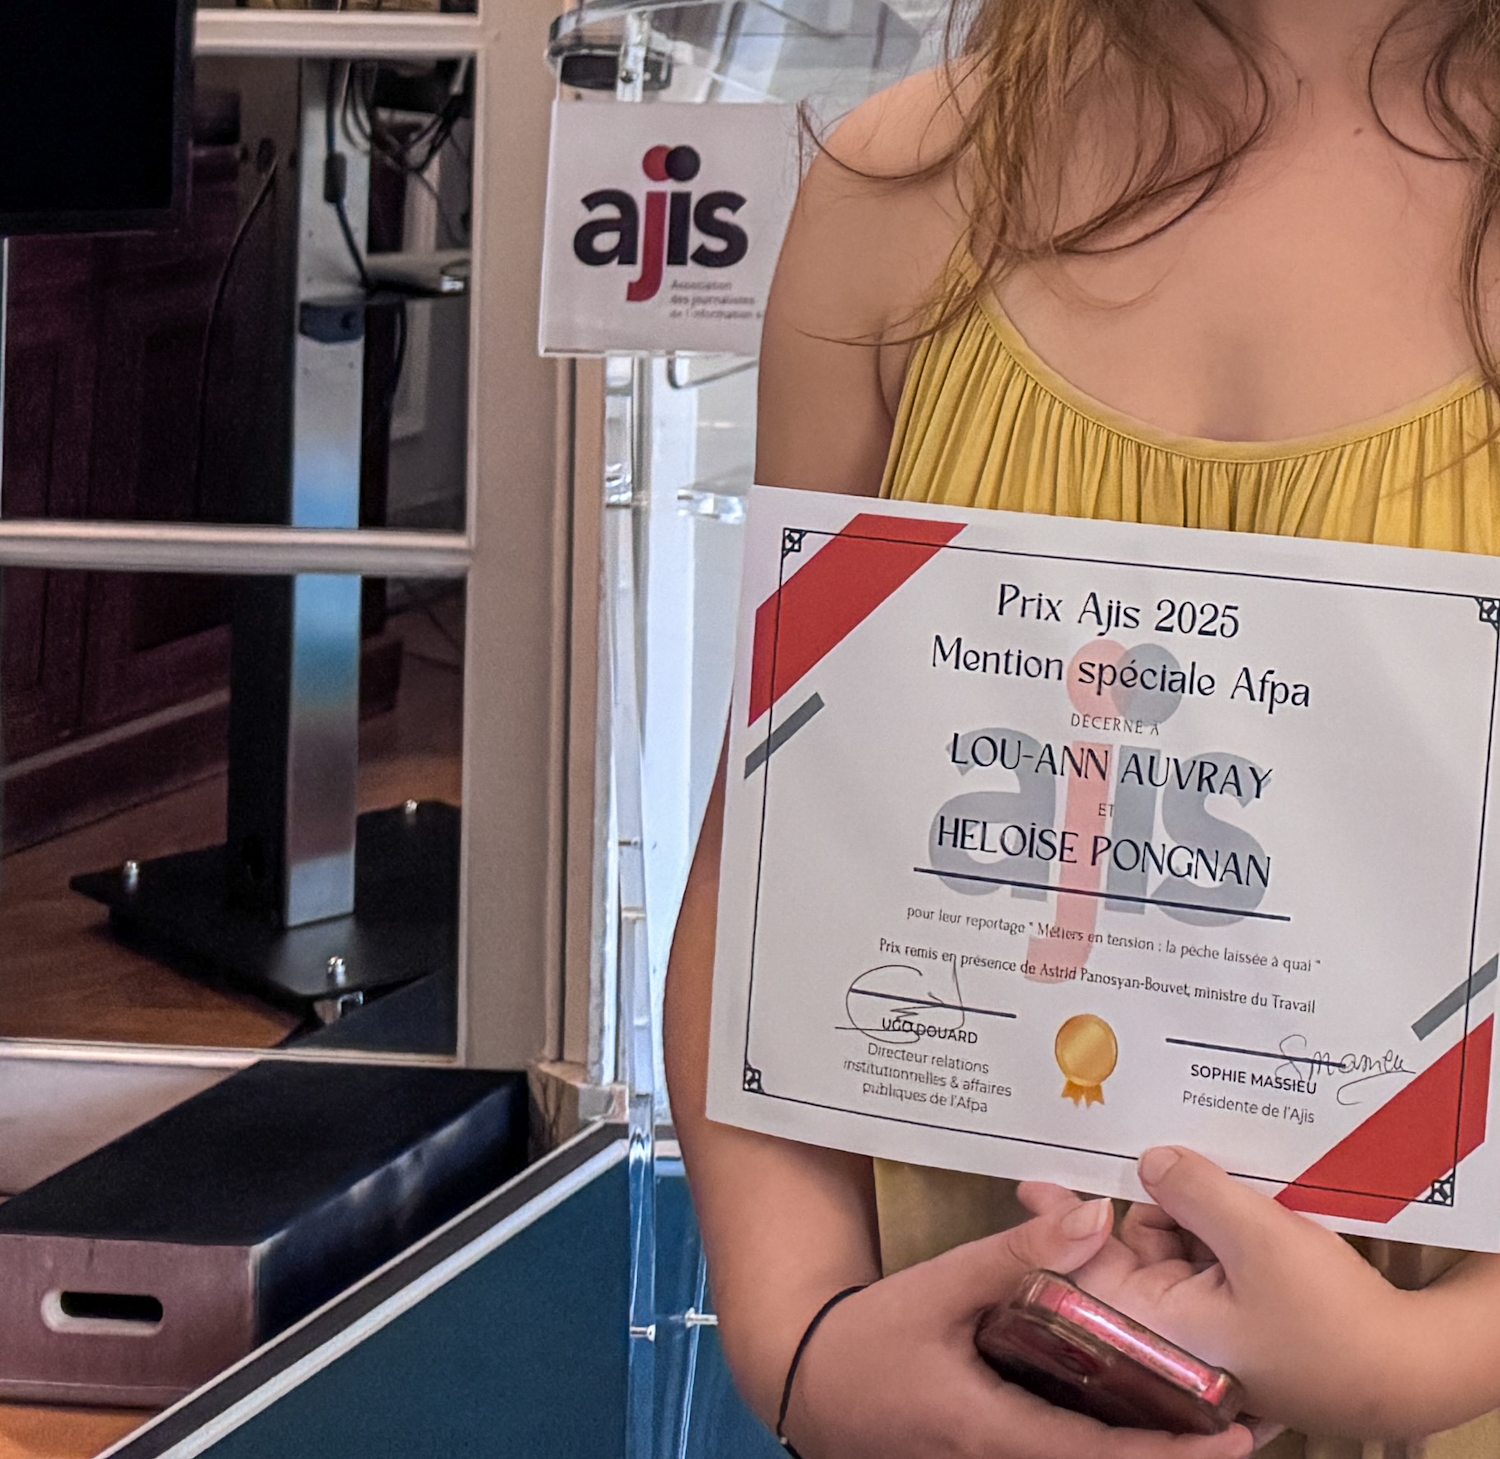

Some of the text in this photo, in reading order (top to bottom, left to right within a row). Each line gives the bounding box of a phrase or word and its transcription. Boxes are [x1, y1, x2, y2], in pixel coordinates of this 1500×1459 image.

[573, 144, 748, 302] ajis
[998, 583, 1239, 638] Prix Ajis 2025
[932, 634, 1310, 714] Mention spéciale Afpa
[951, 732, 1273, 800] LOU-ANN AUVRAY
[1097, 803, 1115, 818] ET
[1090, 835, 1271, 888] PONGNAN
[907, 906, 935, 921] pour
[938, 908, 961, 924] leur
[965, 916, 1026, 935] reportage
[1088, 933, 1103, 944] en
[1107, 933, 1154, 952] tension
[1165, 939, 1177, 954] la
[1223, 947, 1268, 967] laissée
[1271, 955, 1279, 968] à
[1282, 957, 1312, 972] quai
[879, 937, 901, 955] Prix
[905, 944, 938, 960] remis
[942, 951, 956, 963] en
[960, 953, 1017, 972] présence
[1020, 960, 1036, 975] de
[1039, 963, 1077, 980] Astrid
[1194, 986, 1247, 1005] ministre
[1251, 992, 1268, 1007] du
[1272, 994, 1316, 1014] Travail
[916, 1023, 978, 1044] DOUARD
[843, 1059, 1012, 1097] institutionnelles & affaires
[868, 1042, 990, 1074] Directeur relations
[1190, 1064, 1317, 1095] SOPHIE MASSIEU
[862, 1081, 988, 1114] publiques de l'Afpa
[1182, 1090, 1315, 1126] Présidente de l'Ajis
